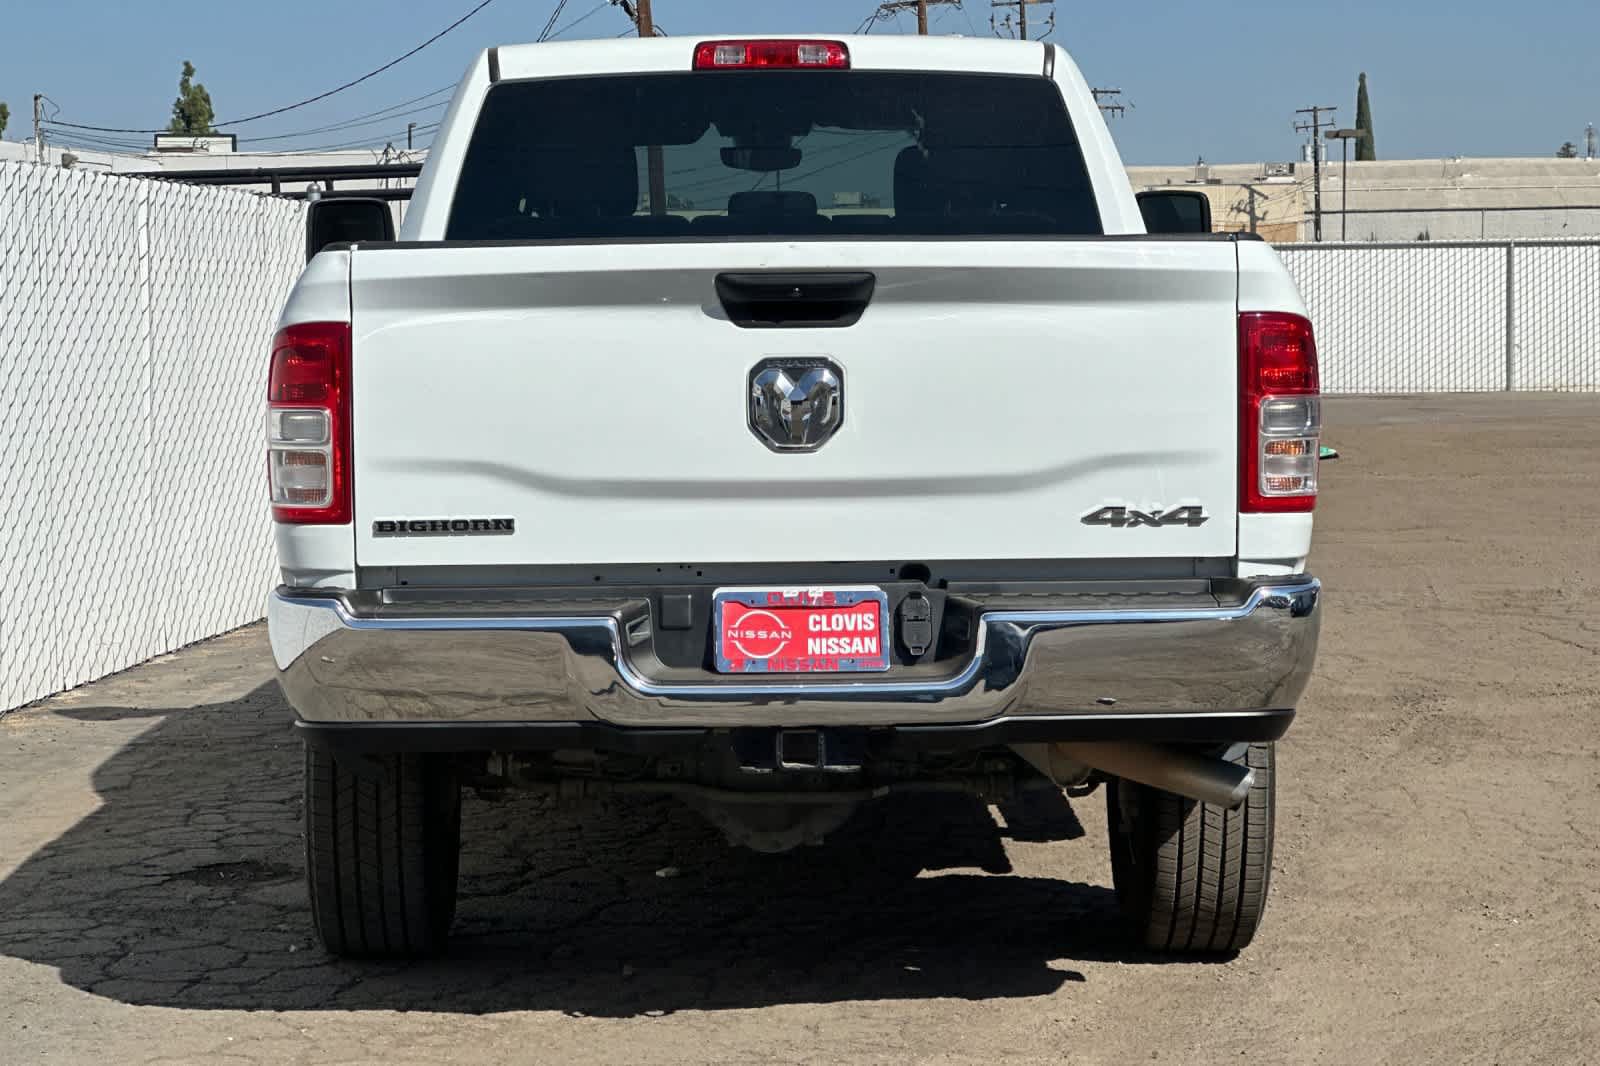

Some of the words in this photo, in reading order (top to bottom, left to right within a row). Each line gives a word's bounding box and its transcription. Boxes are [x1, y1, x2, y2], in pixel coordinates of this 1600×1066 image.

[372, 518, 515, 537] BIGHORN
[808, 613, 875, 632] CLOVIS
[727, 629, 792, 640] NISSAN
[807, 636, 877, 655] NISSAN
